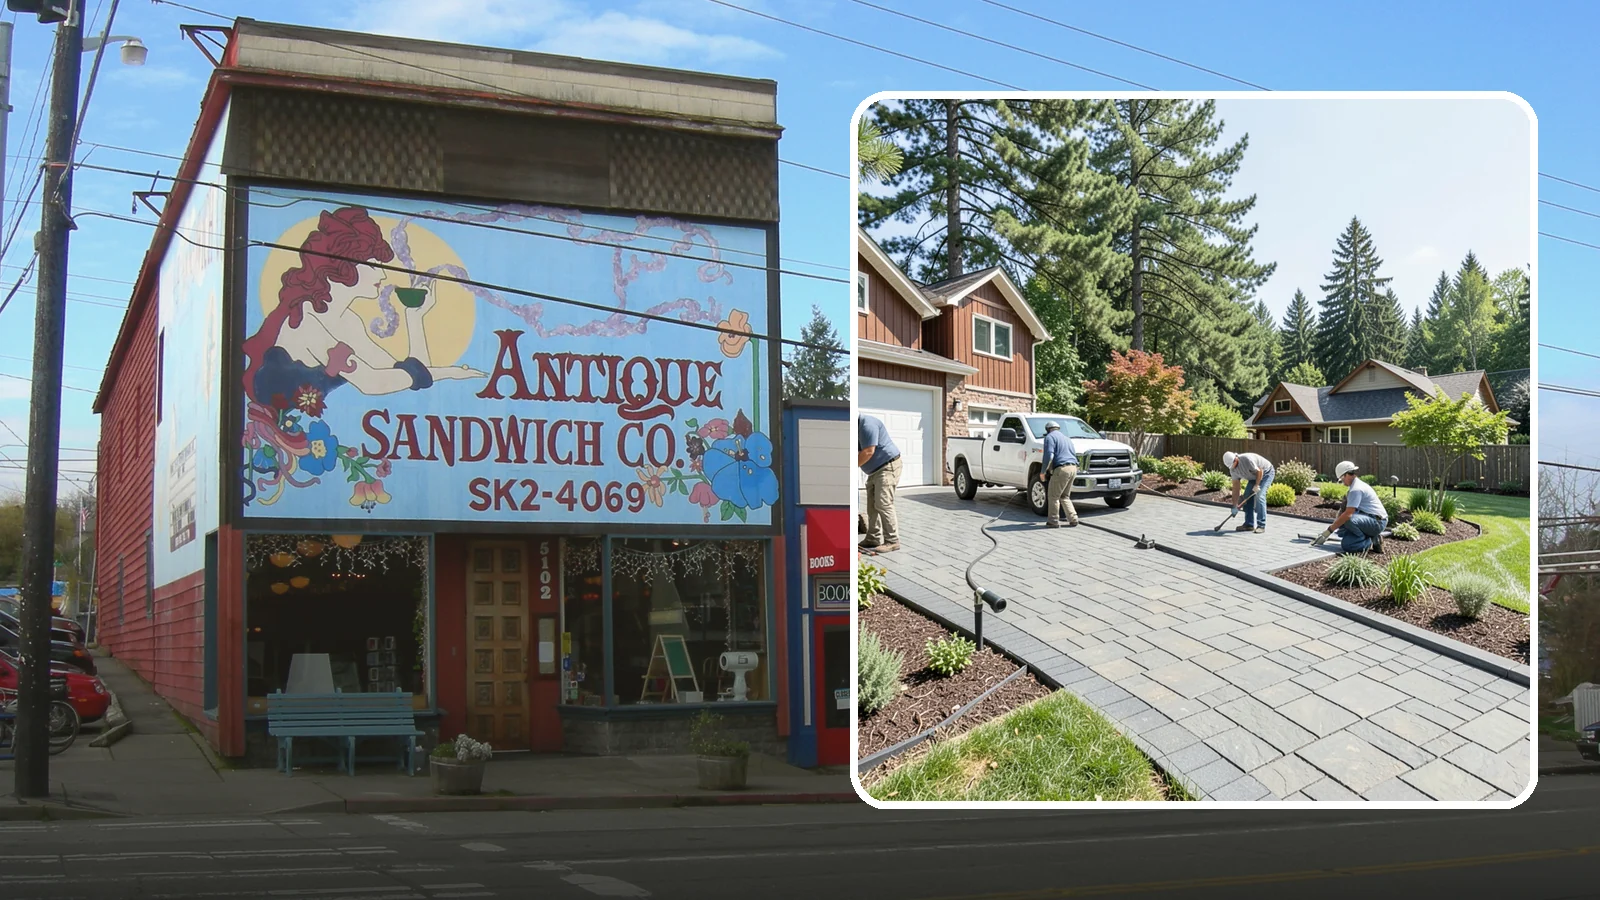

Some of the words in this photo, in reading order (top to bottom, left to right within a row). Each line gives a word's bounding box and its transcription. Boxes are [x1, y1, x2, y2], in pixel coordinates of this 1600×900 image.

[476, 330, 724, 420] ANTIQUE
[361, 409, 604, 467] SANDWICH
[616, 422, 685, 469] CO.
[468, 478, 646, 513] SK2-4069
[540, 541, 551, 600] 5102
[809, 555, 835, 569] BOOKS
